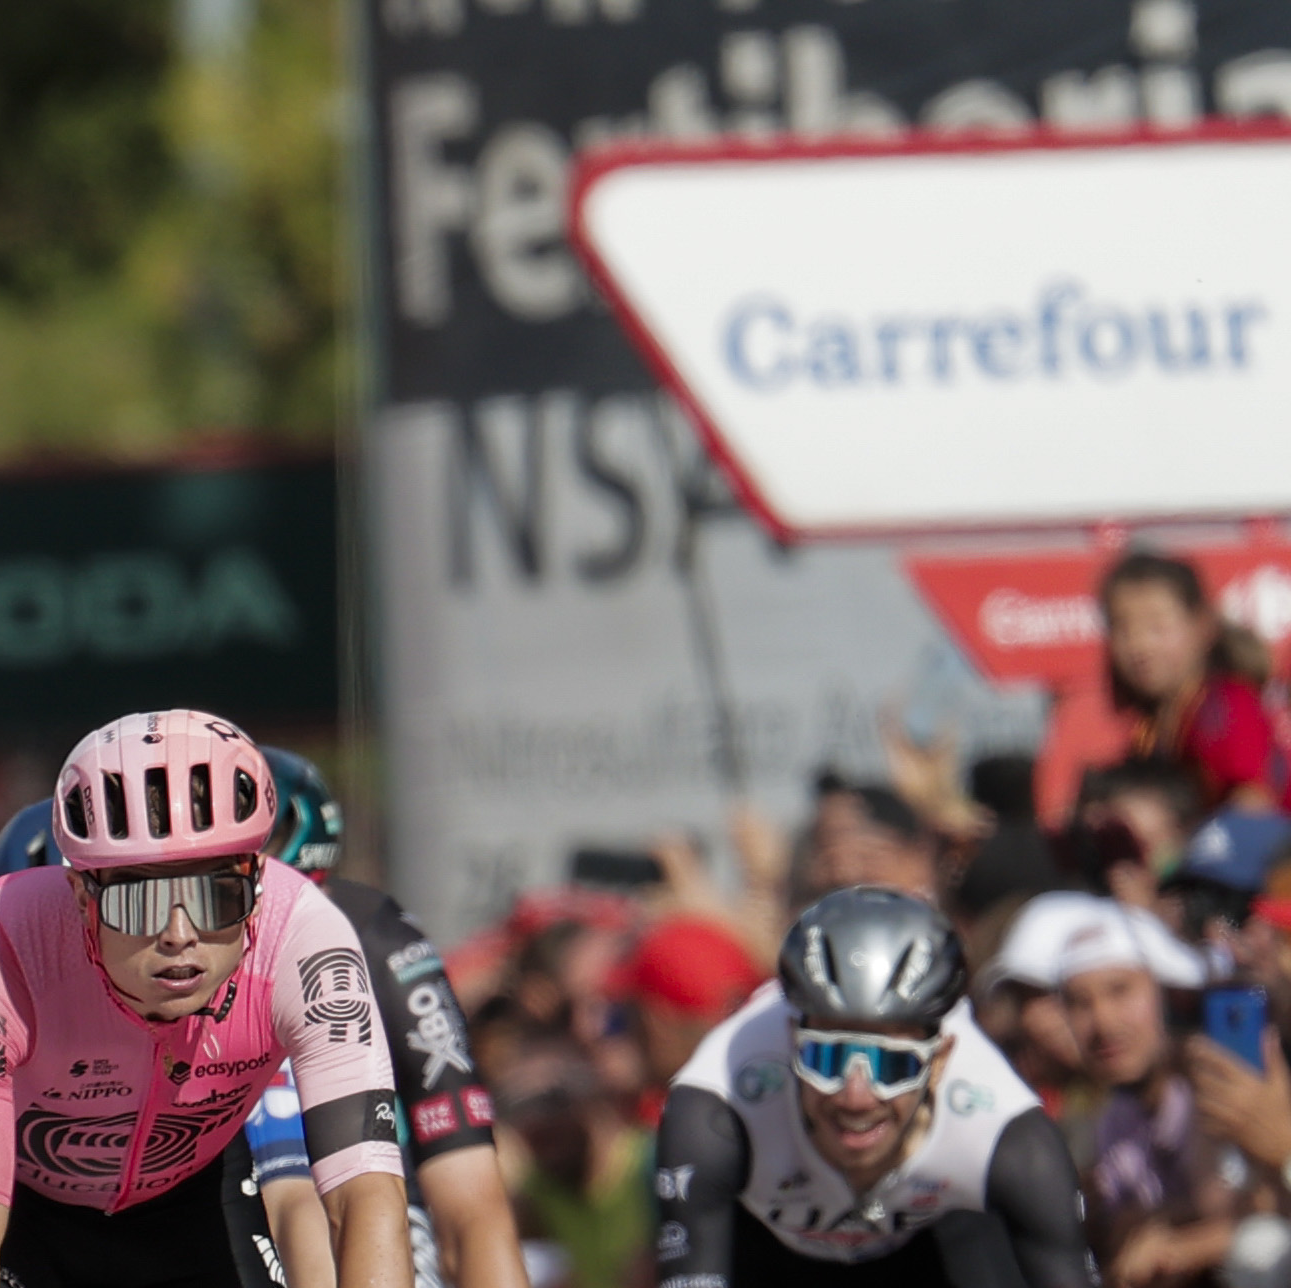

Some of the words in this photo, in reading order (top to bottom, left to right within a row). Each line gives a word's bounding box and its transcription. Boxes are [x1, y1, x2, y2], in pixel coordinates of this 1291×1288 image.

[722, 277, 1267, 390] Carrefour
[194, 1052, 272, 1079] easypost
[68, 1086, 133, 1101] NIPPO
